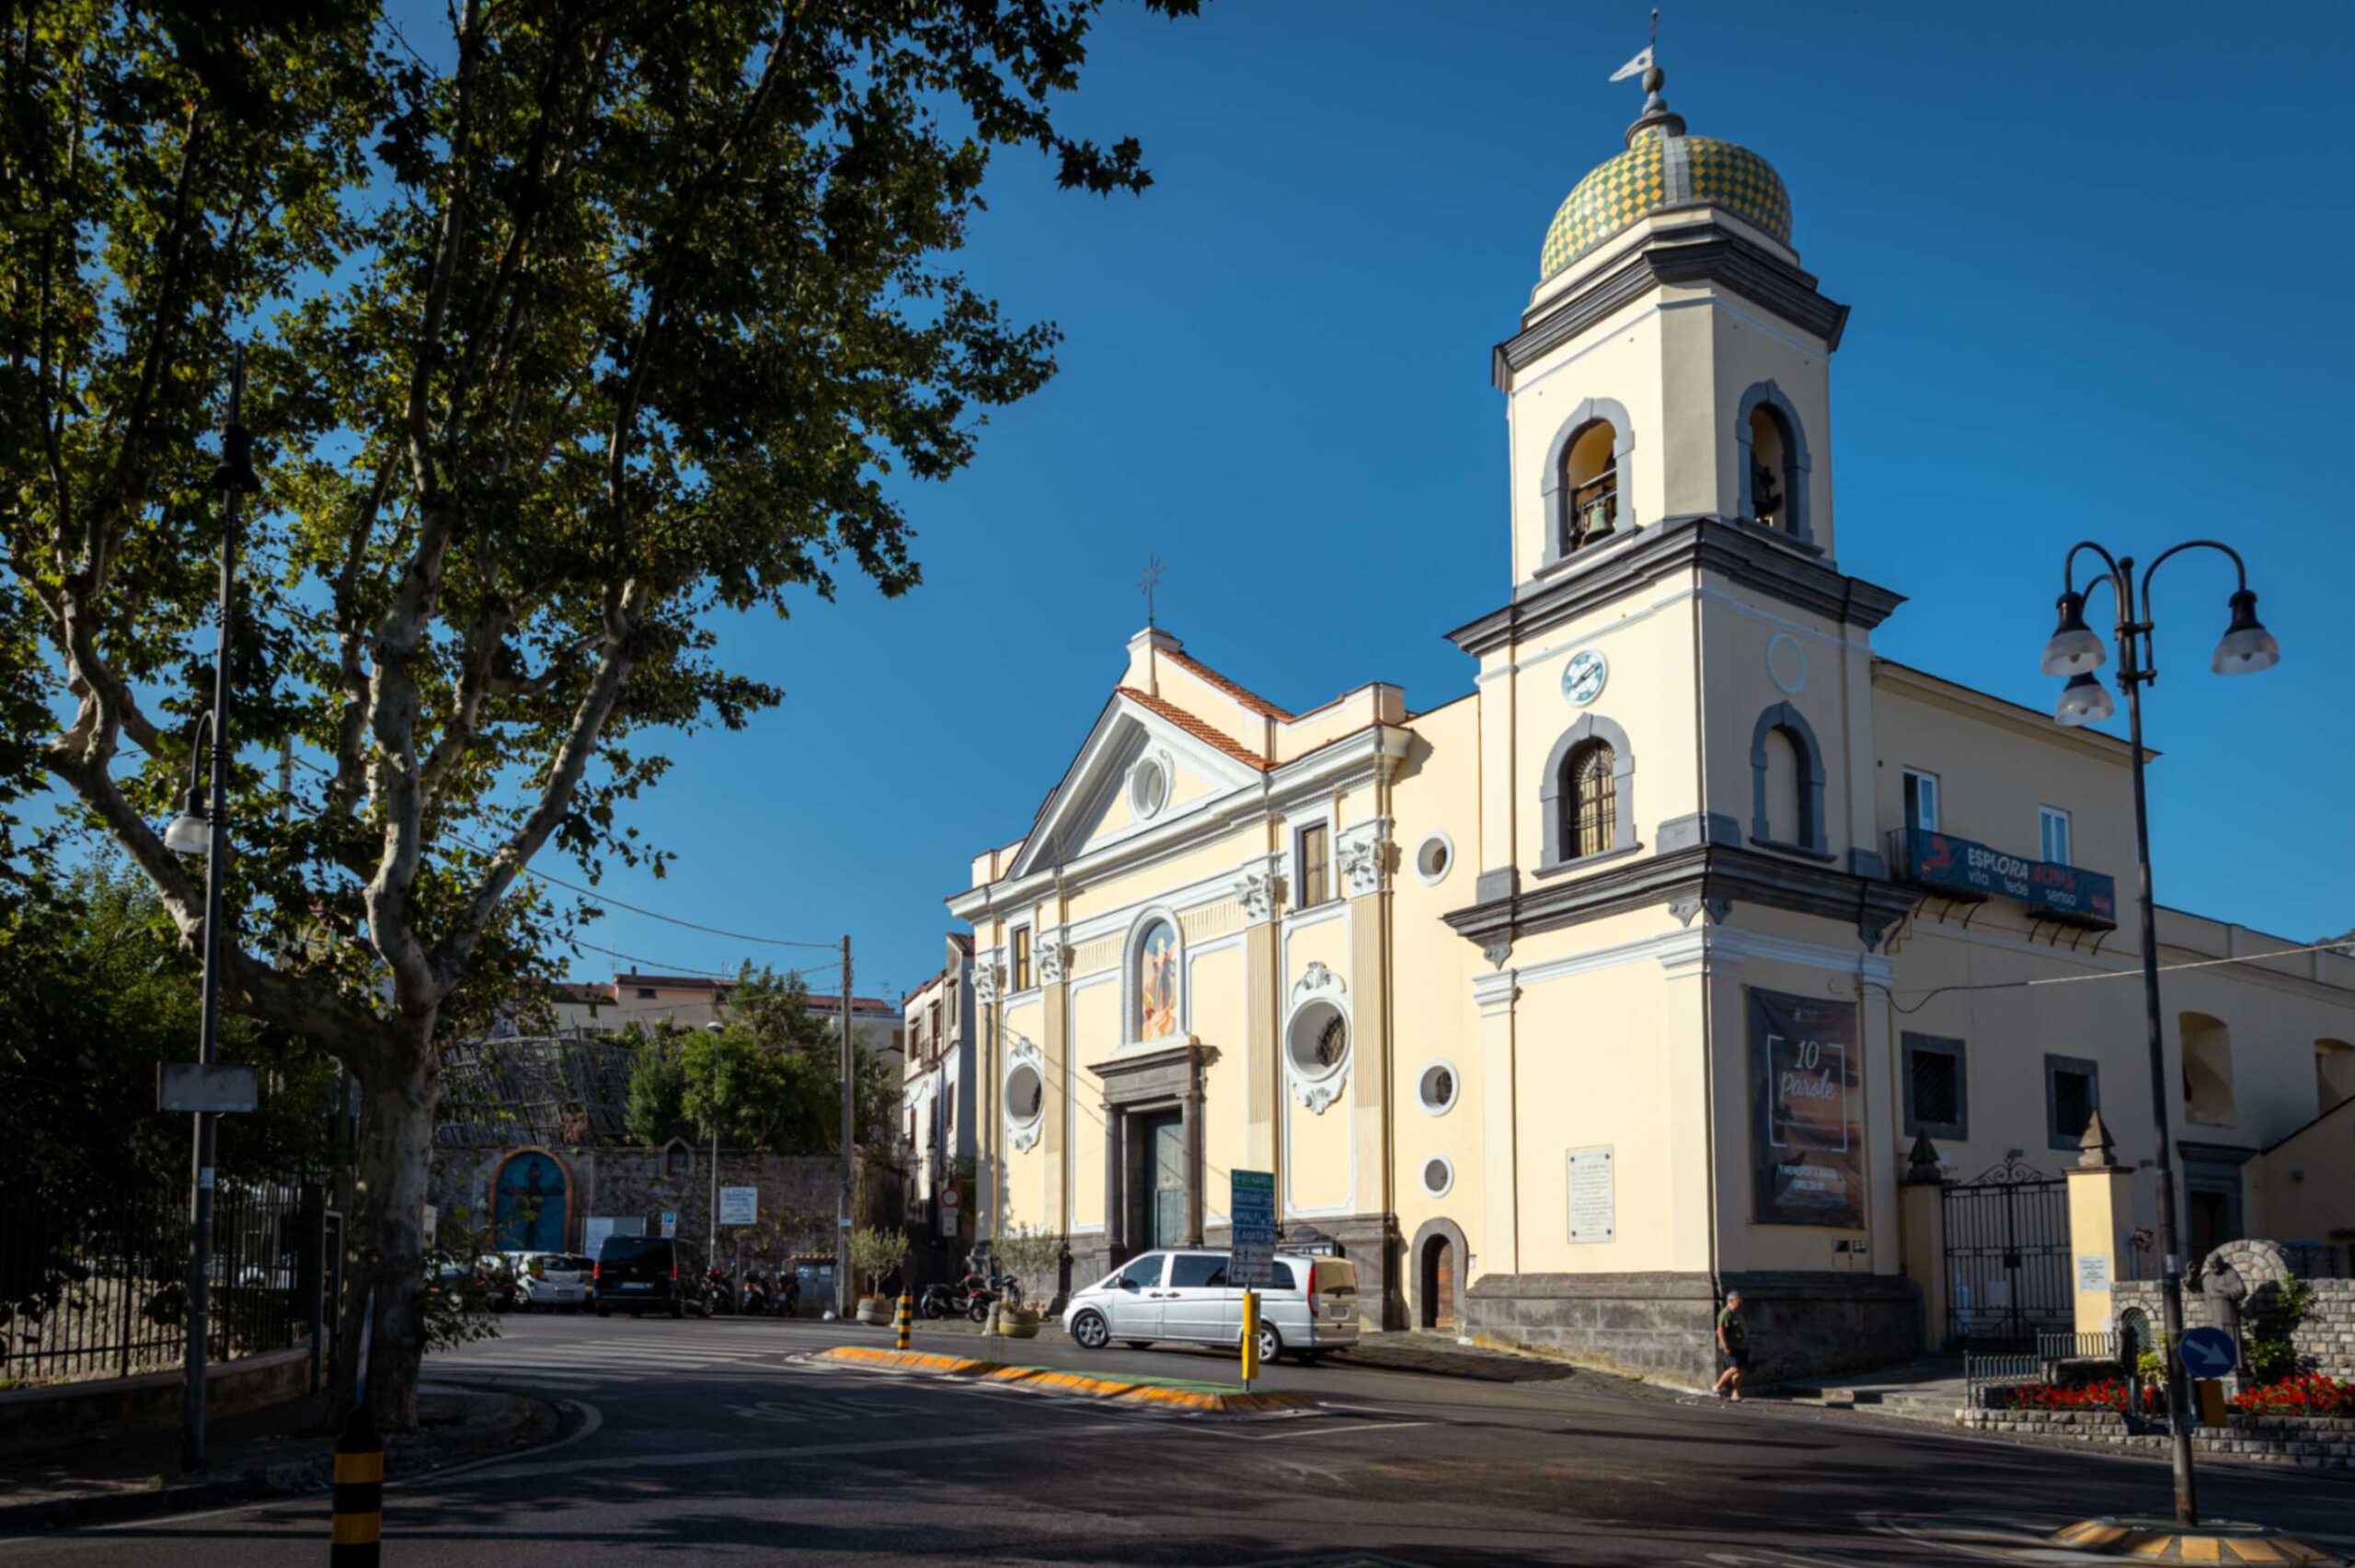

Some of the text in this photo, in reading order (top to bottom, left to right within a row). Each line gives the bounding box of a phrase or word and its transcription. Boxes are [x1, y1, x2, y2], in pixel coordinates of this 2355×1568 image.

[1968, 848, 2028, 879] ESPLORA
[1969, 869, 1989, 885] vita
[2045, 888, 2076, 906] senso
[1795, 1039, 1820, 1070] 10
